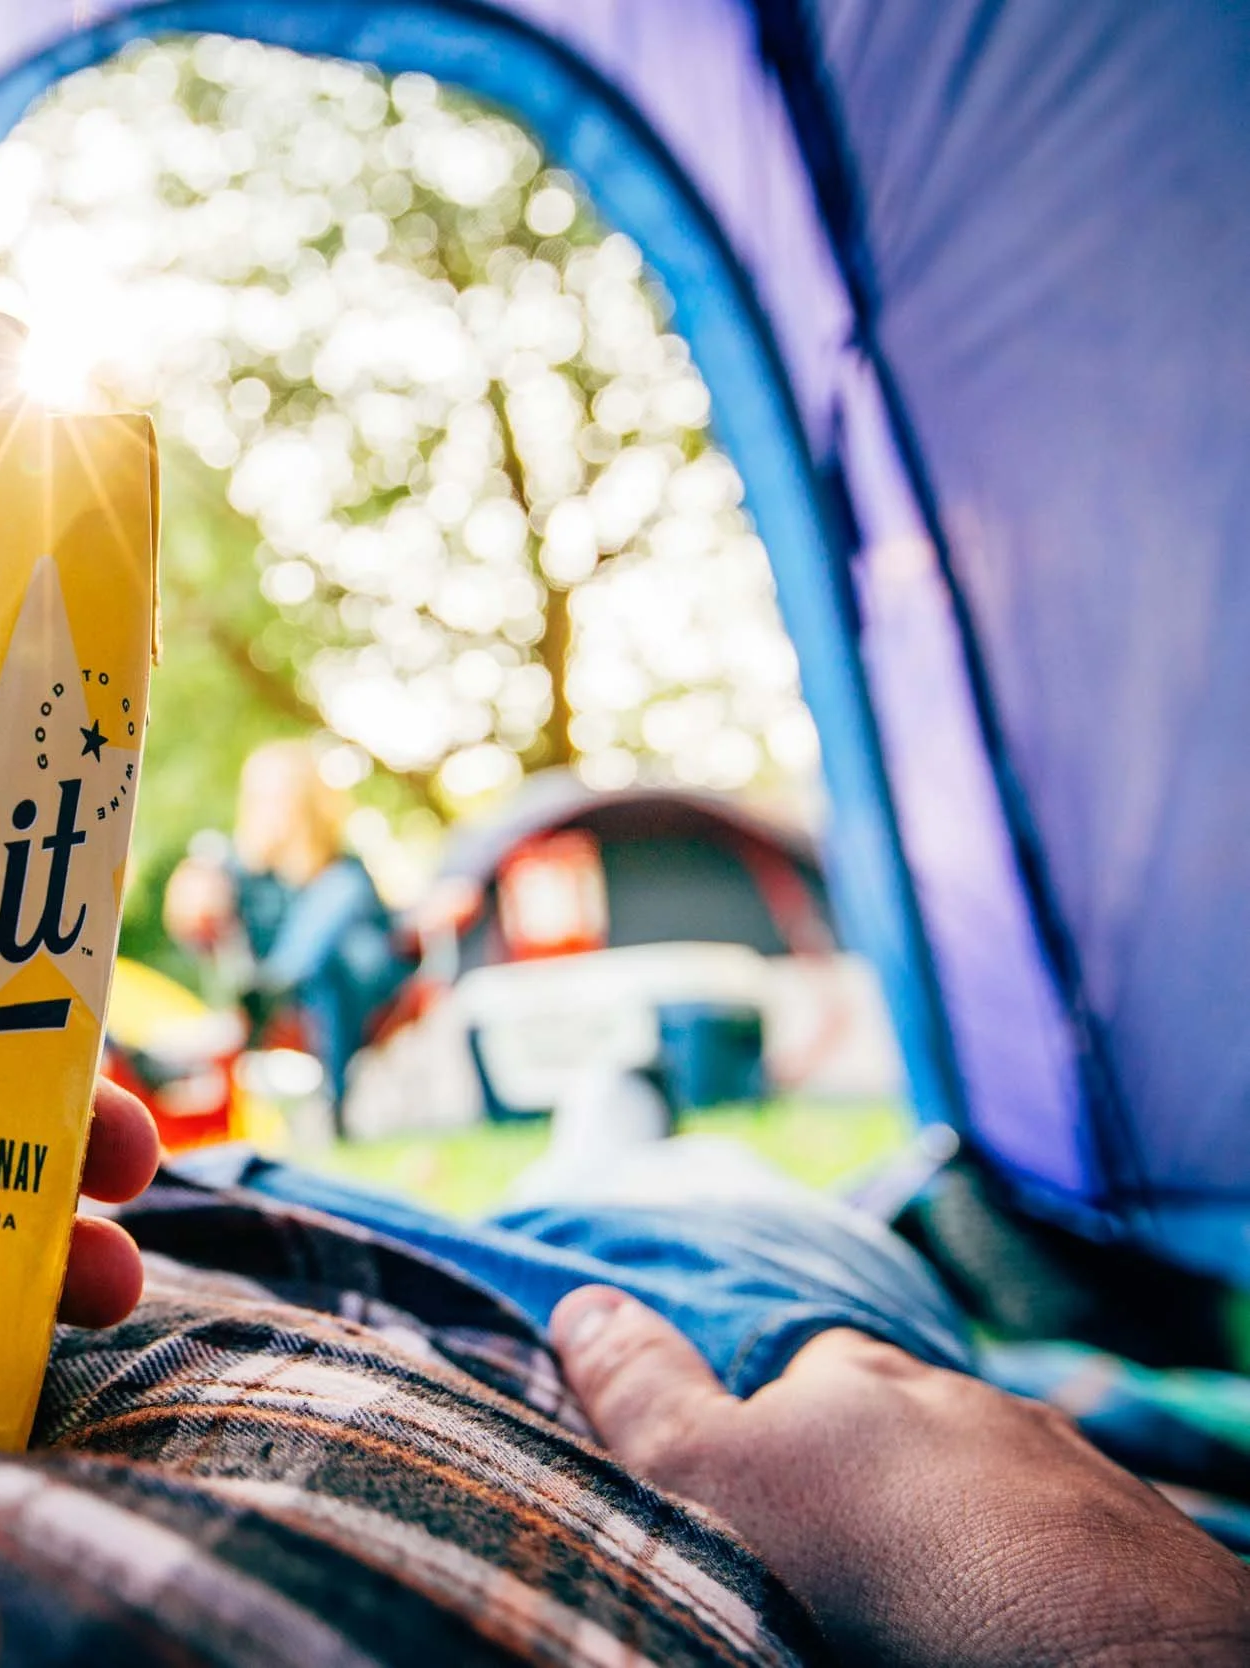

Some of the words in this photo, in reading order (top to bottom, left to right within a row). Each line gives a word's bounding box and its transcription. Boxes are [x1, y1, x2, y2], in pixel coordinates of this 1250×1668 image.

[82, 669, 109, 685] TO
[35, 683, 65, 769] GOOD
[121, 698, 135, 736] GO
[96, 763, 134, 820] WINE
